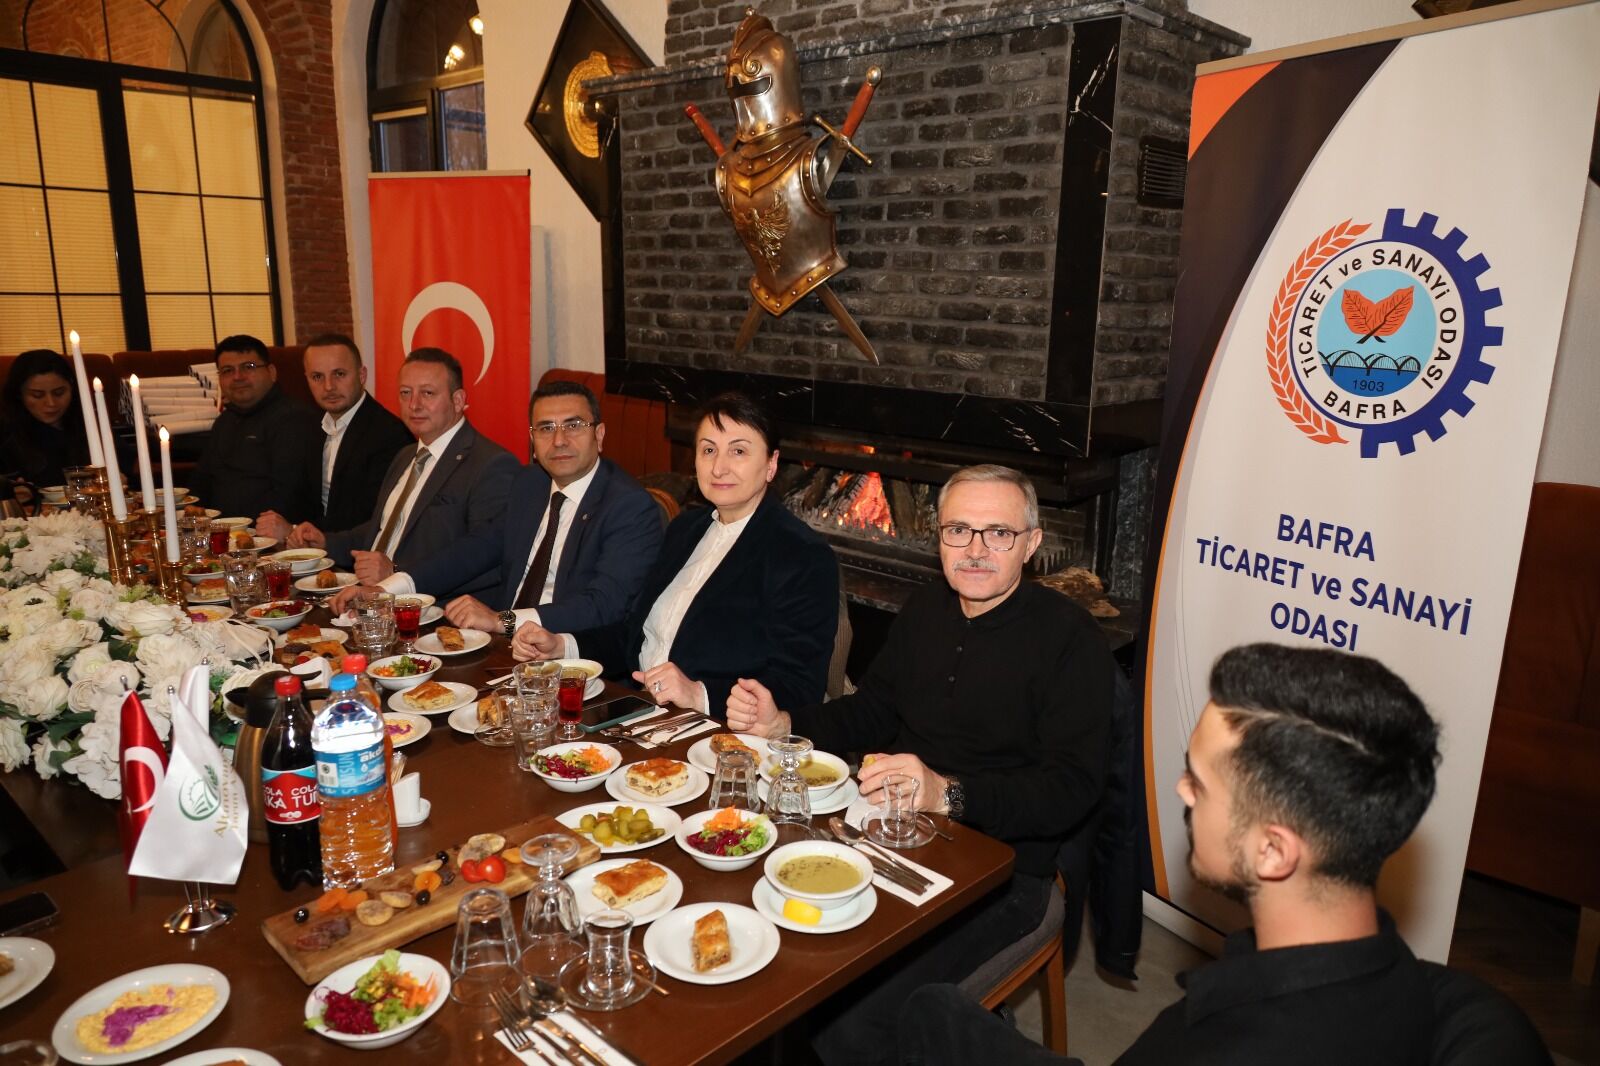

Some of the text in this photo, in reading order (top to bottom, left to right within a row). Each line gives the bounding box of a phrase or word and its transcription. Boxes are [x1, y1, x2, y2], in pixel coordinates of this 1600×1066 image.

[1338, 258, 1362, 276] ve
[1421, 307, 1457, 390] ODASI
[1323, 390, 1407, 420] BAFRA
[1352, 379, 1384, 392] 1903
[1276, 513, 1376, 562] BAFRA
[1196, 535, 1473, 636] TİCARET ve SANAYİ
[1270, 602, 1359, 652] ODASI
